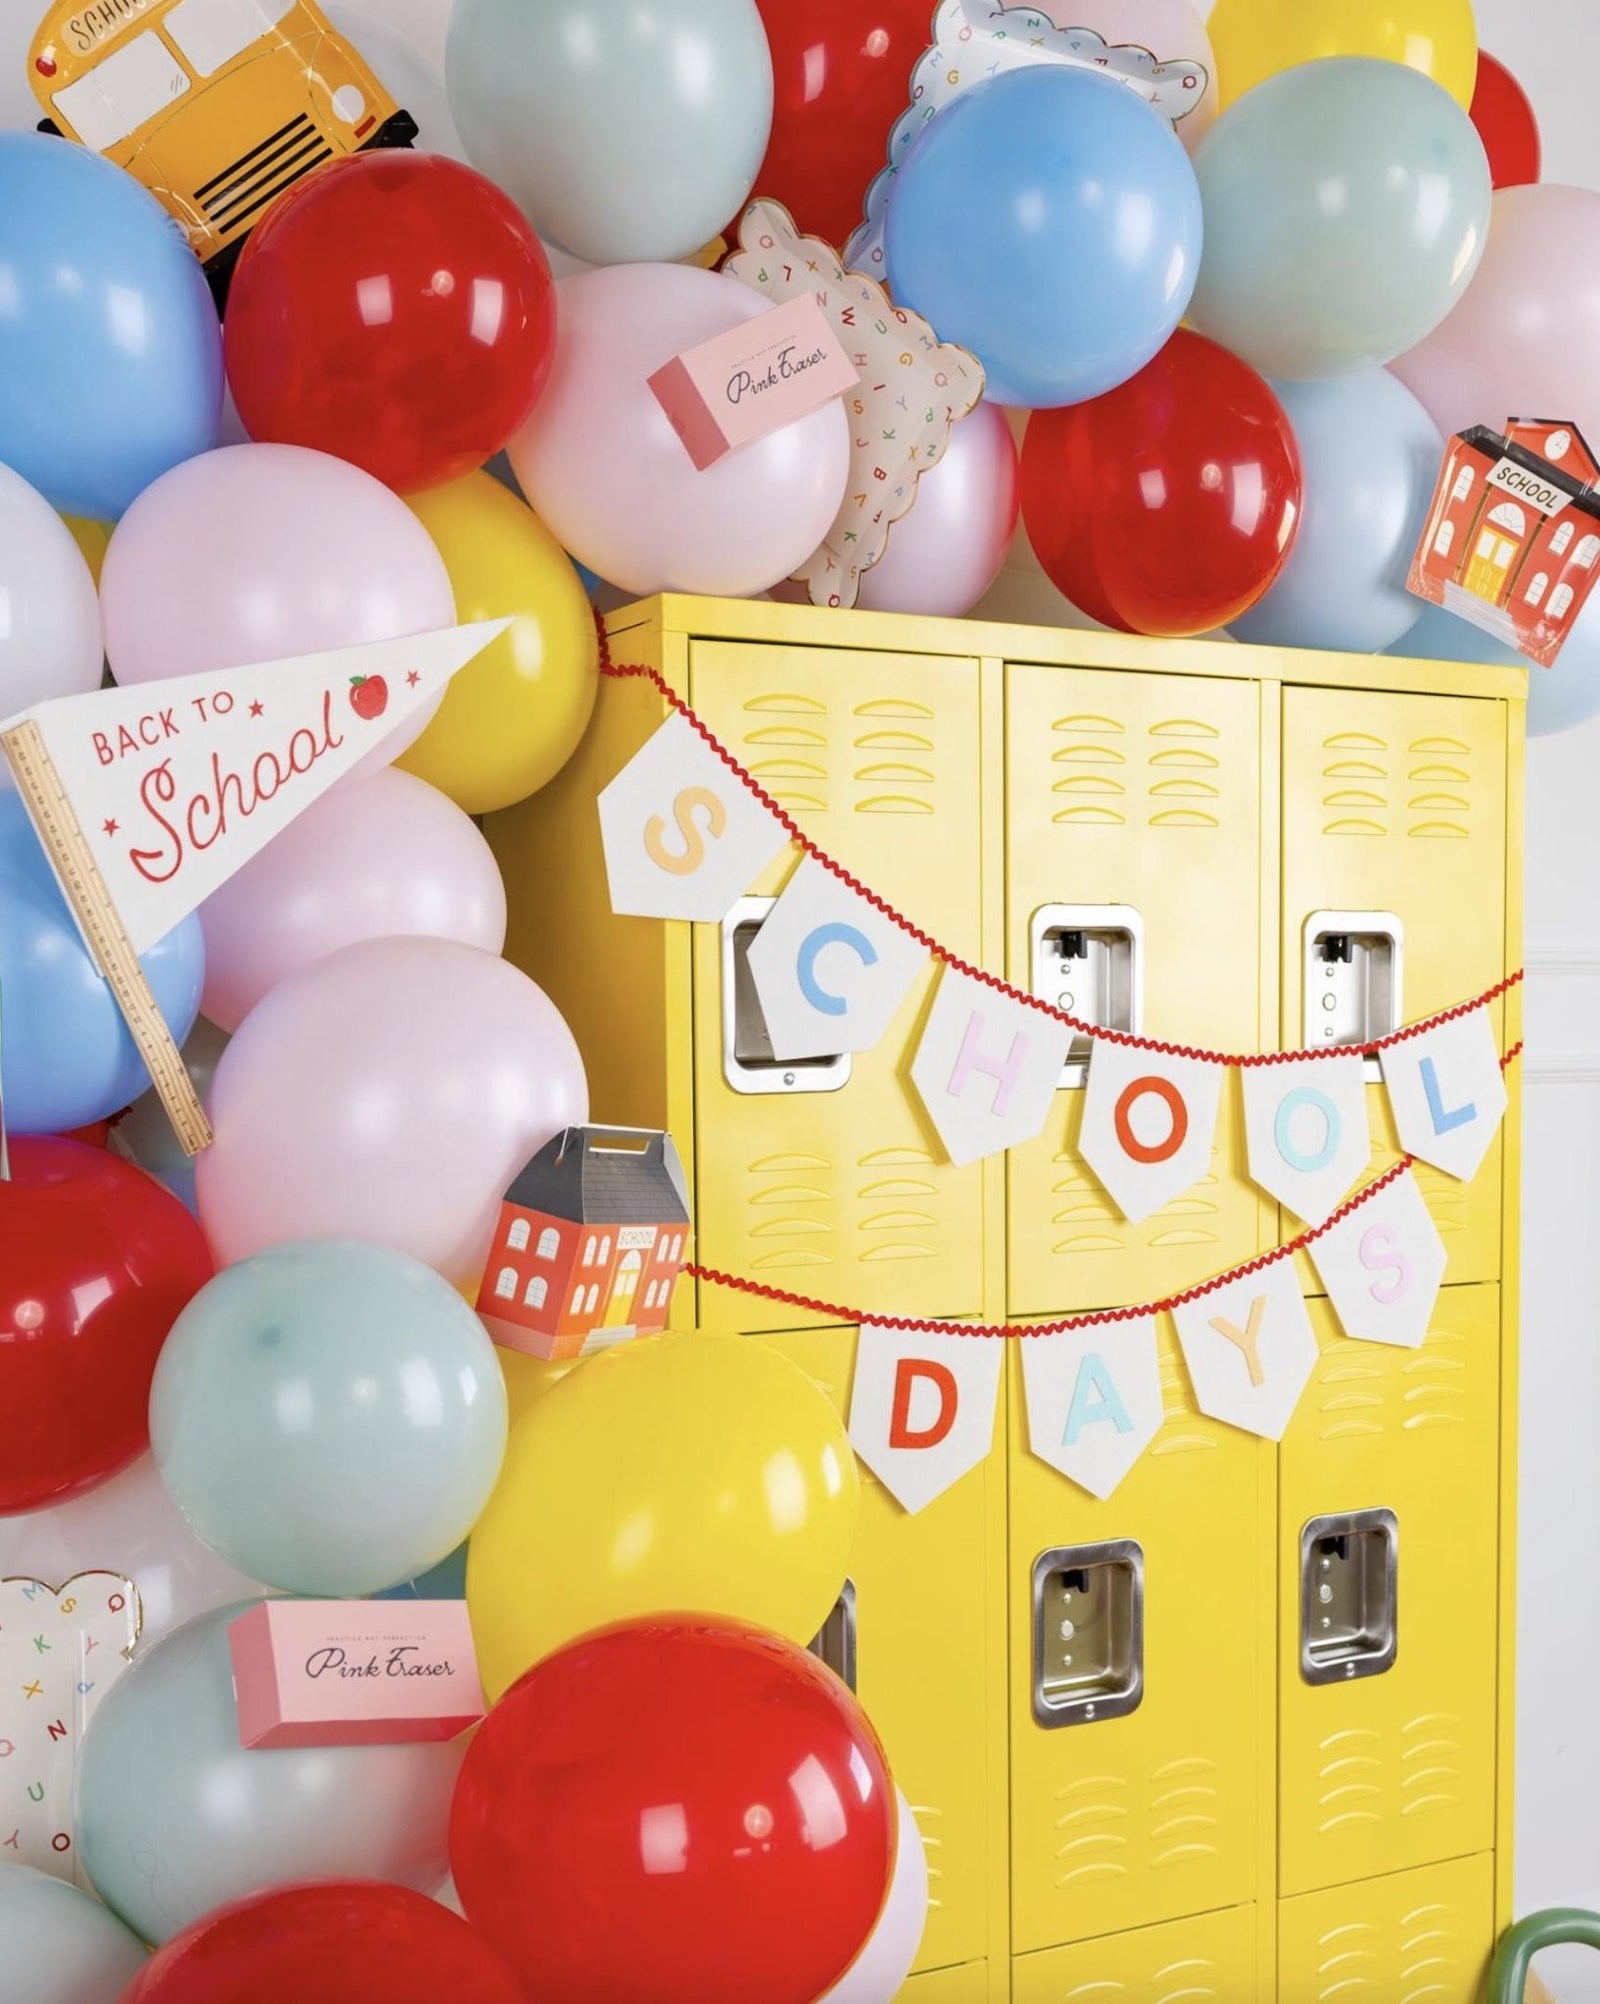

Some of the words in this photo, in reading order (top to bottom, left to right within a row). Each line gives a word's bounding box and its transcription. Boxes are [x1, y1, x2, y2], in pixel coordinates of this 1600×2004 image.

[947, 70, 960, 84] G
[1182, 75, 1197, 89] Q
[913, 85, 924, 99] O
[760, 235, 775, 249] Q
[875, 319, 888, 334] U
[896, 311, 907, 324] O
[727, 366, 778, 404] Pink
[777, 345, 827, 379] Eraser
[935, 372, 948, 387] Q
[853, 400, 864, 414] S
[882, 429, 896, 439] K
[908, 445, 918, 461] X
[873, 467, 887, 481] B
[1497, 467, 1557, 508] SCHOOL
[92, 708, 180, 766] BACK
[191, 691, 234, 722] TO
[129, 690, 344, 883] School
[643, 785, 1477, 1174] SCHOOL
[889, 1223, 1415, 1450] DAYS
[60, 1597, 77, 1614] S
[108, 1593, 125, 1614] Q
[33, 1634, 52, 1655] K
[85, 1636, 100, 1656] Y
[305, 1647, 380, 1678] Pink
[386, 1646, 455, 1677] Eraser
[22, 1679, 44, 1700] X
[27, 1782, 44, 1802] U
[3, 1829, 19, 1850] Y
[52, 1832, 70, 1852] O
